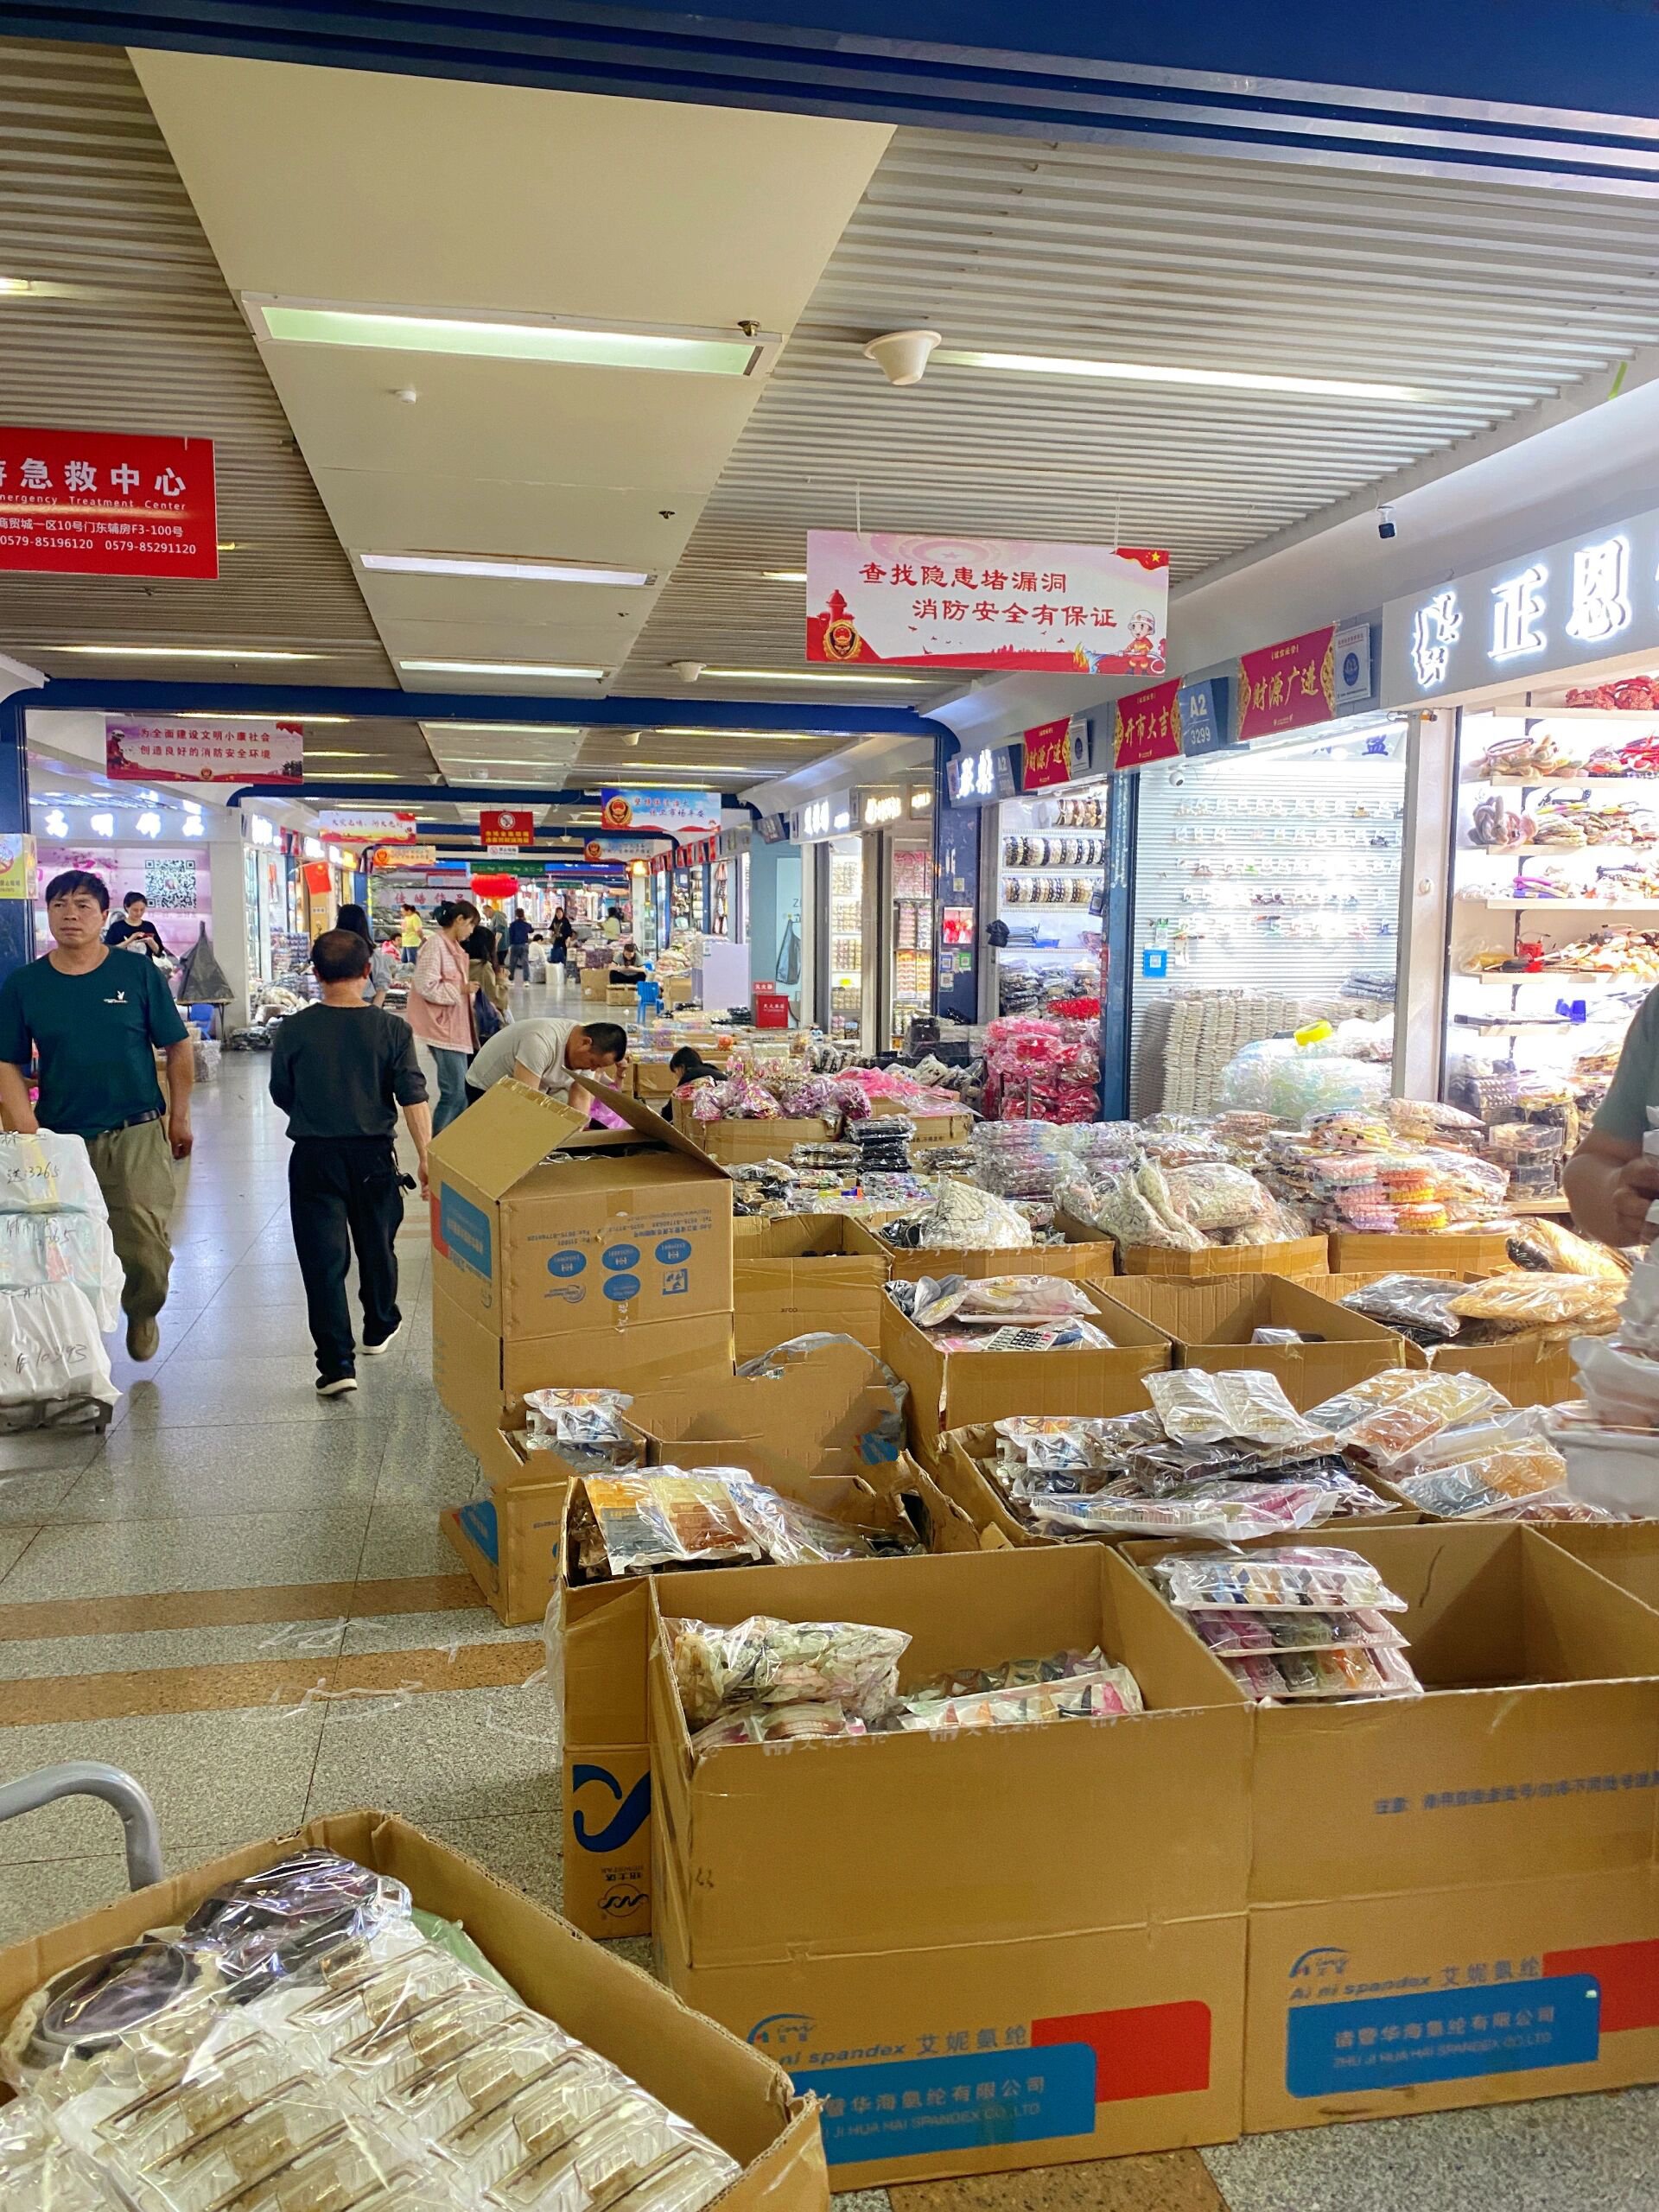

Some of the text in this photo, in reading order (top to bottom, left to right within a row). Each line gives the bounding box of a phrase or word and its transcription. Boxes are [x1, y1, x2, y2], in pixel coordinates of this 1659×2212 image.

[69, 496, 134, 508] Treatment
[144, 499, 187, 511] Center
[0, 535, 196, 555] 0579-85196120 0579-85291120
[859, 562, 1066, 594] 查找隐患堵漏洞
[1487, 535, 1659, 663] 正恩
[912, 598, 1118, 628] 消防安全有保证
[1252, 658, 1319, 711] 财源广进
[1190, 694, 1208, 718] A2
[140, 728, 270, 742] 为全面建设文明小康社会
[1124, 705, 1170, 747] 开市大吉
[1190, 727, 1211, 745] 3299
[140, 744, 271, 759] 创造良好的消防安全环境
[1344, 1975, 1432, 1996] spandex
[809, 2043, 906, 2066] spandex
[824, 2075, 1046, 2118] 暨华海氨纶有限公司
